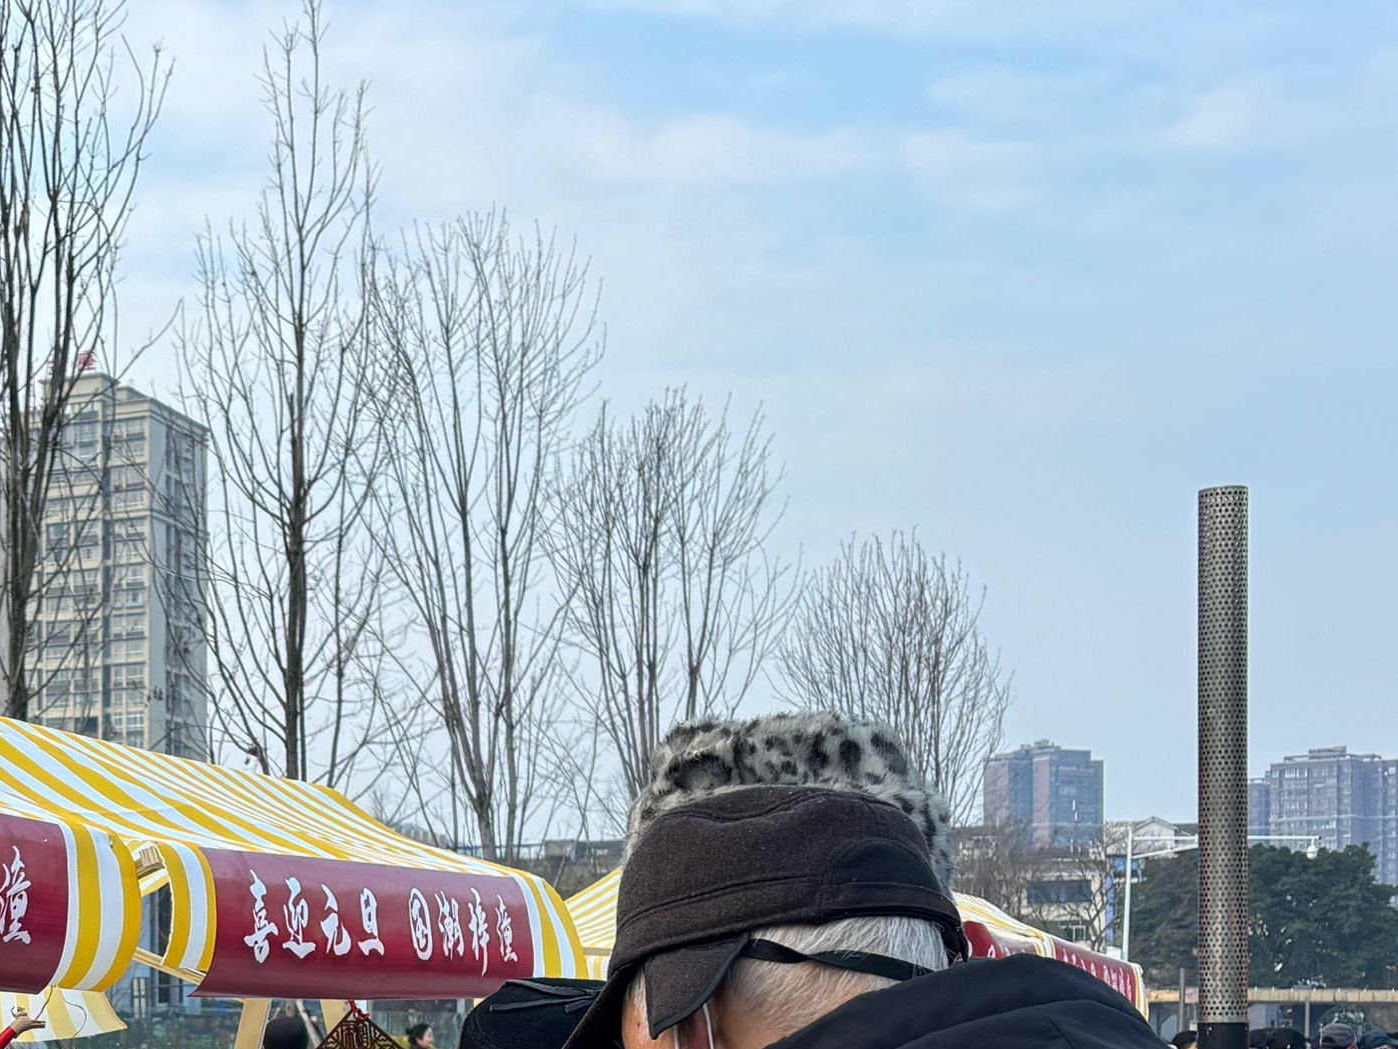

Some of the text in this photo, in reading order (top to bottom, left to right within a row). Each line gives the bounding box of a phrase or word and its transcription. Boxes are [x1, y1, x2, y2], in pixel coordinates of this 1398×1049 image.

[244, 868, 519, 977] 喜迎元旦 国潮梓潼
